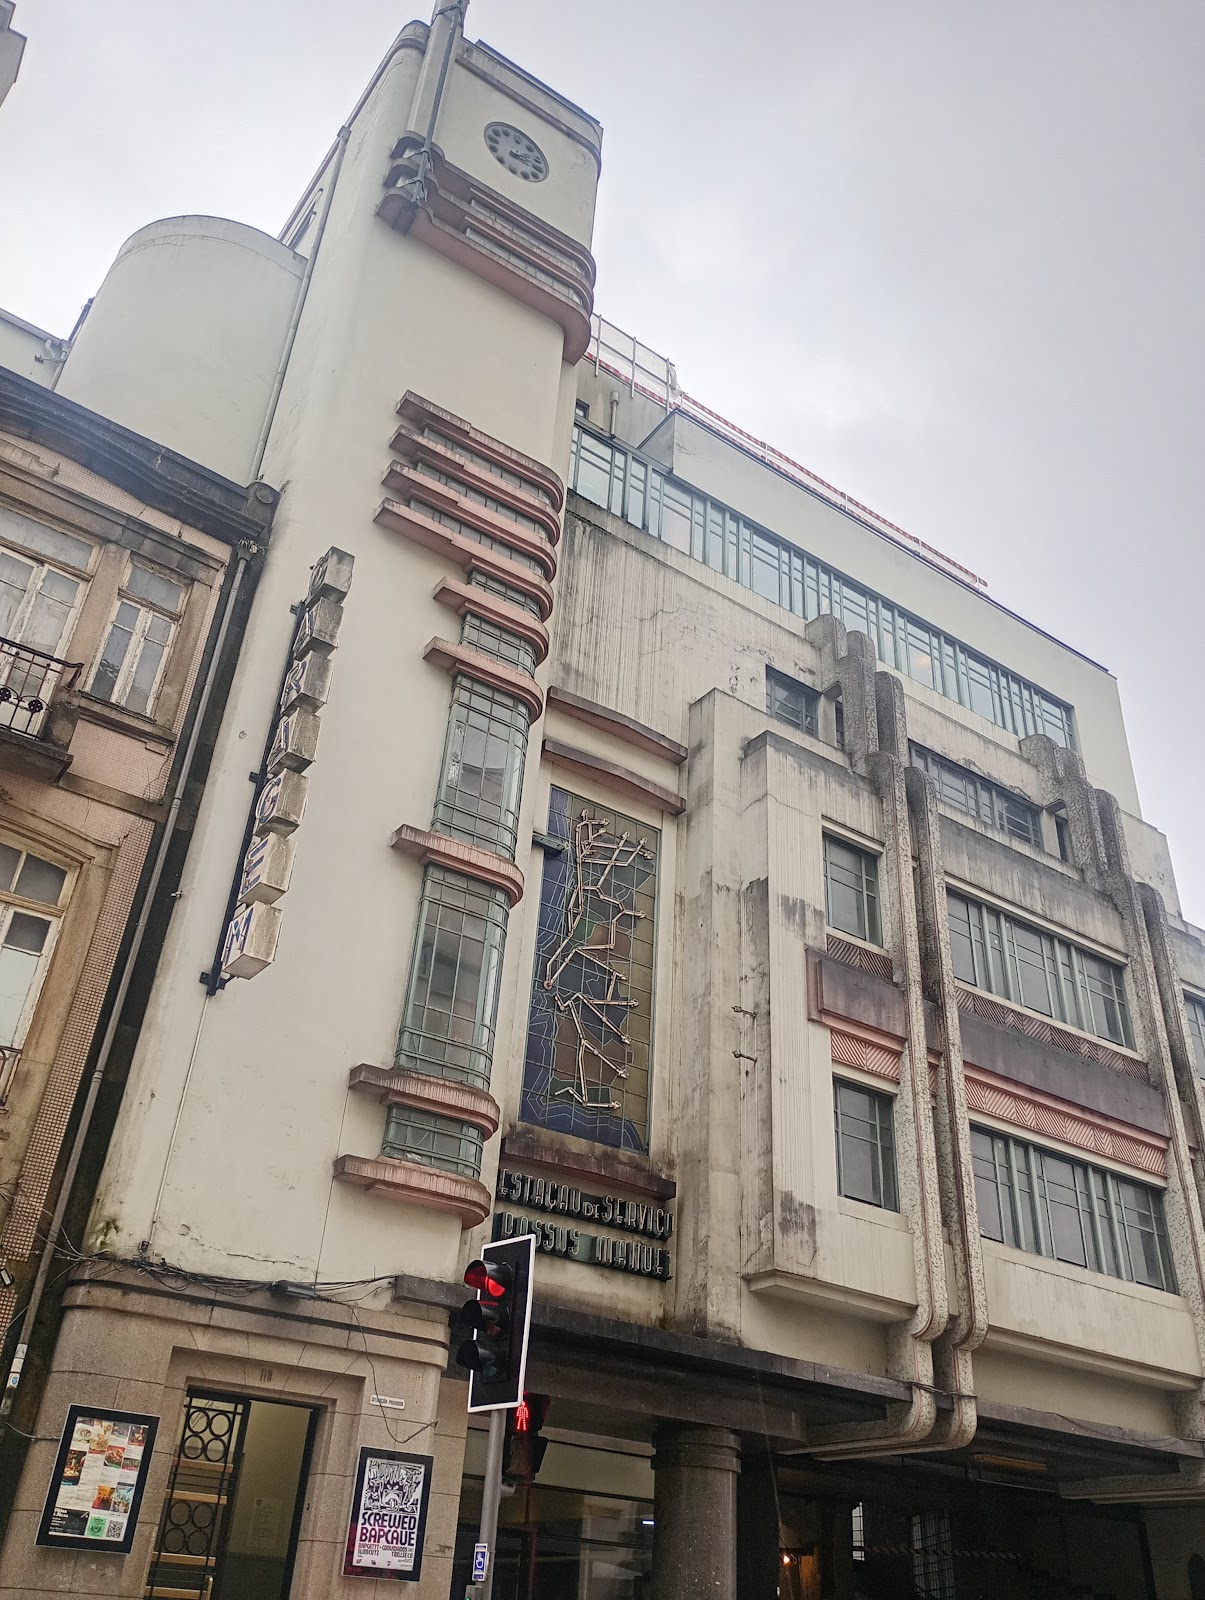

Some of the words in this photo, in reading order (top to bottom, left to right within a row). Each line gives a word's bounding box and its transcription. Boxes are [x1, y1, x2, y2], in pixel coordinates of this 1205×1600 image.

[582, 1201, 601, 1219] DE
[602, 1195, 674, 1237] SERVIÇO
[361, 1512, 417, 1530] SCREWED
